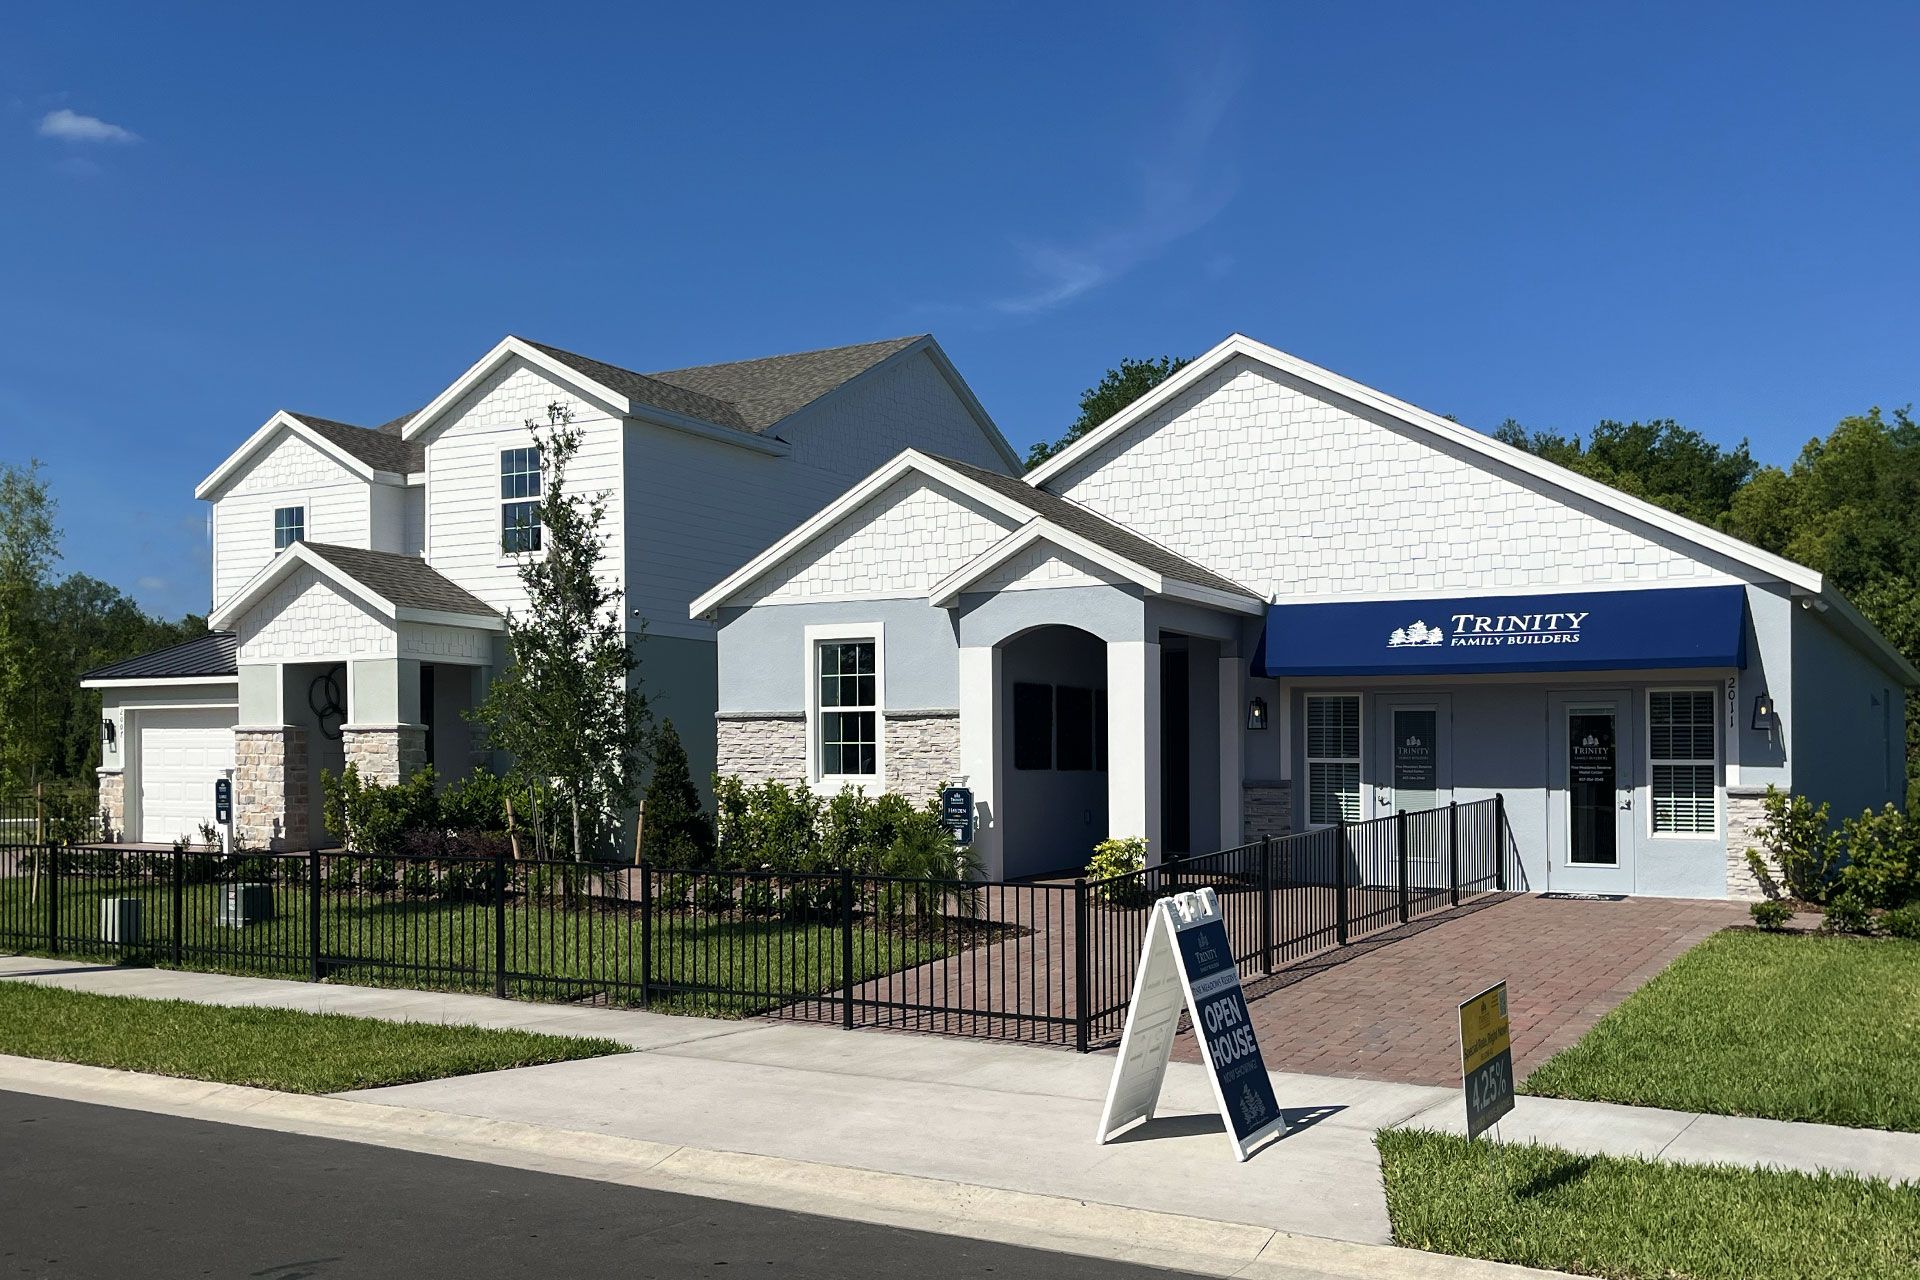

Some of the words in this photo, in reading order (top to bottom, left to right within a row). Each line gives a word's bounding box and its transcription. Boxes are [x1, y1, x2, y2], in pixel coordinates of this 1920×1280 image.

[1451, 612, 1590, 633] TRINITY
[1450, 636, 1504, 647] FAMILY
[1507, 634, 1580, 645] BUILDERS
[1727, 677, 1736, 728] 2011
[1397, 746, 1430, 755] TRINITY
[1572, 745, 1609, 755] TRINITY
[1195, 949, 1217, 963] TRINITY
[1204, 994, 1243, 1033] OPEN
[1208, 1024, 1257, 1070] HOUSE
[1472, 1059, 1507, 1112] 4.25%
